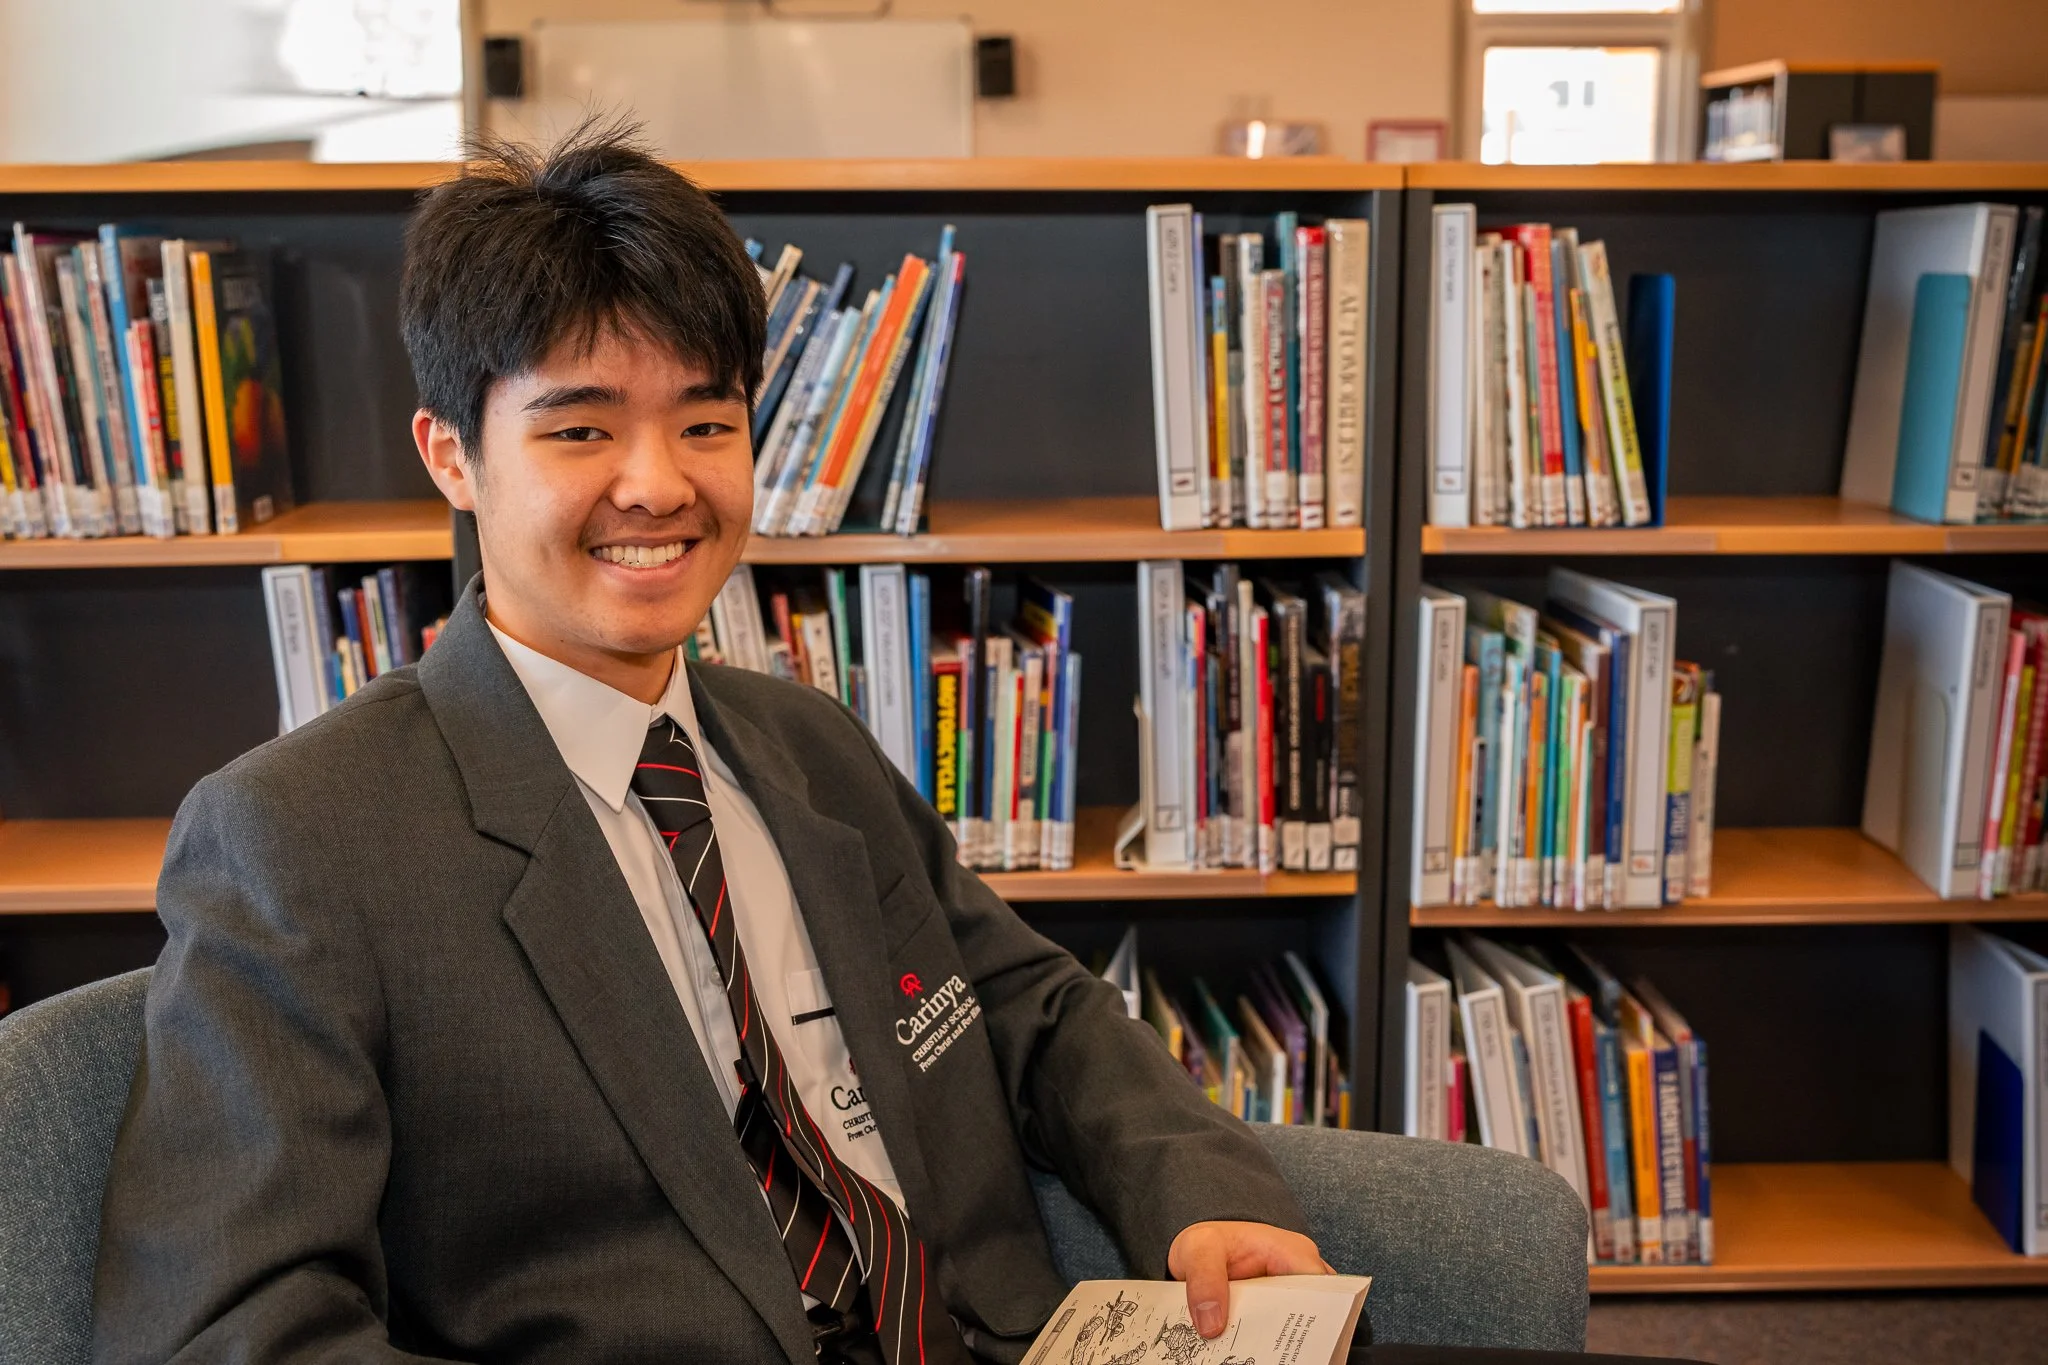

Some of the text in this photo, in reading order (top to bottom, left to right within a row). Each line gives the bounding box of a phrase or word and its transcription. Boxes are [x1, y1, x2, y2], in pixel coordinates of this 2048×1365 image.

[937, 675, 956, 814] MOTORCYCLES
[896, 975, 966, 1045] Carinya
[912, 996, 976, 1062] CHRISTIAN SCHOOL
[918, 1054, 937, 1073] From
[934, 1036, 953, 1056] Christ
[847, 1130, 864, 1142] From
[1285, 1328, 1297, 1351] makes
[1291, 1315, 1316, 1363] The inspector
[1295, 1313, 1304, 1327] and
